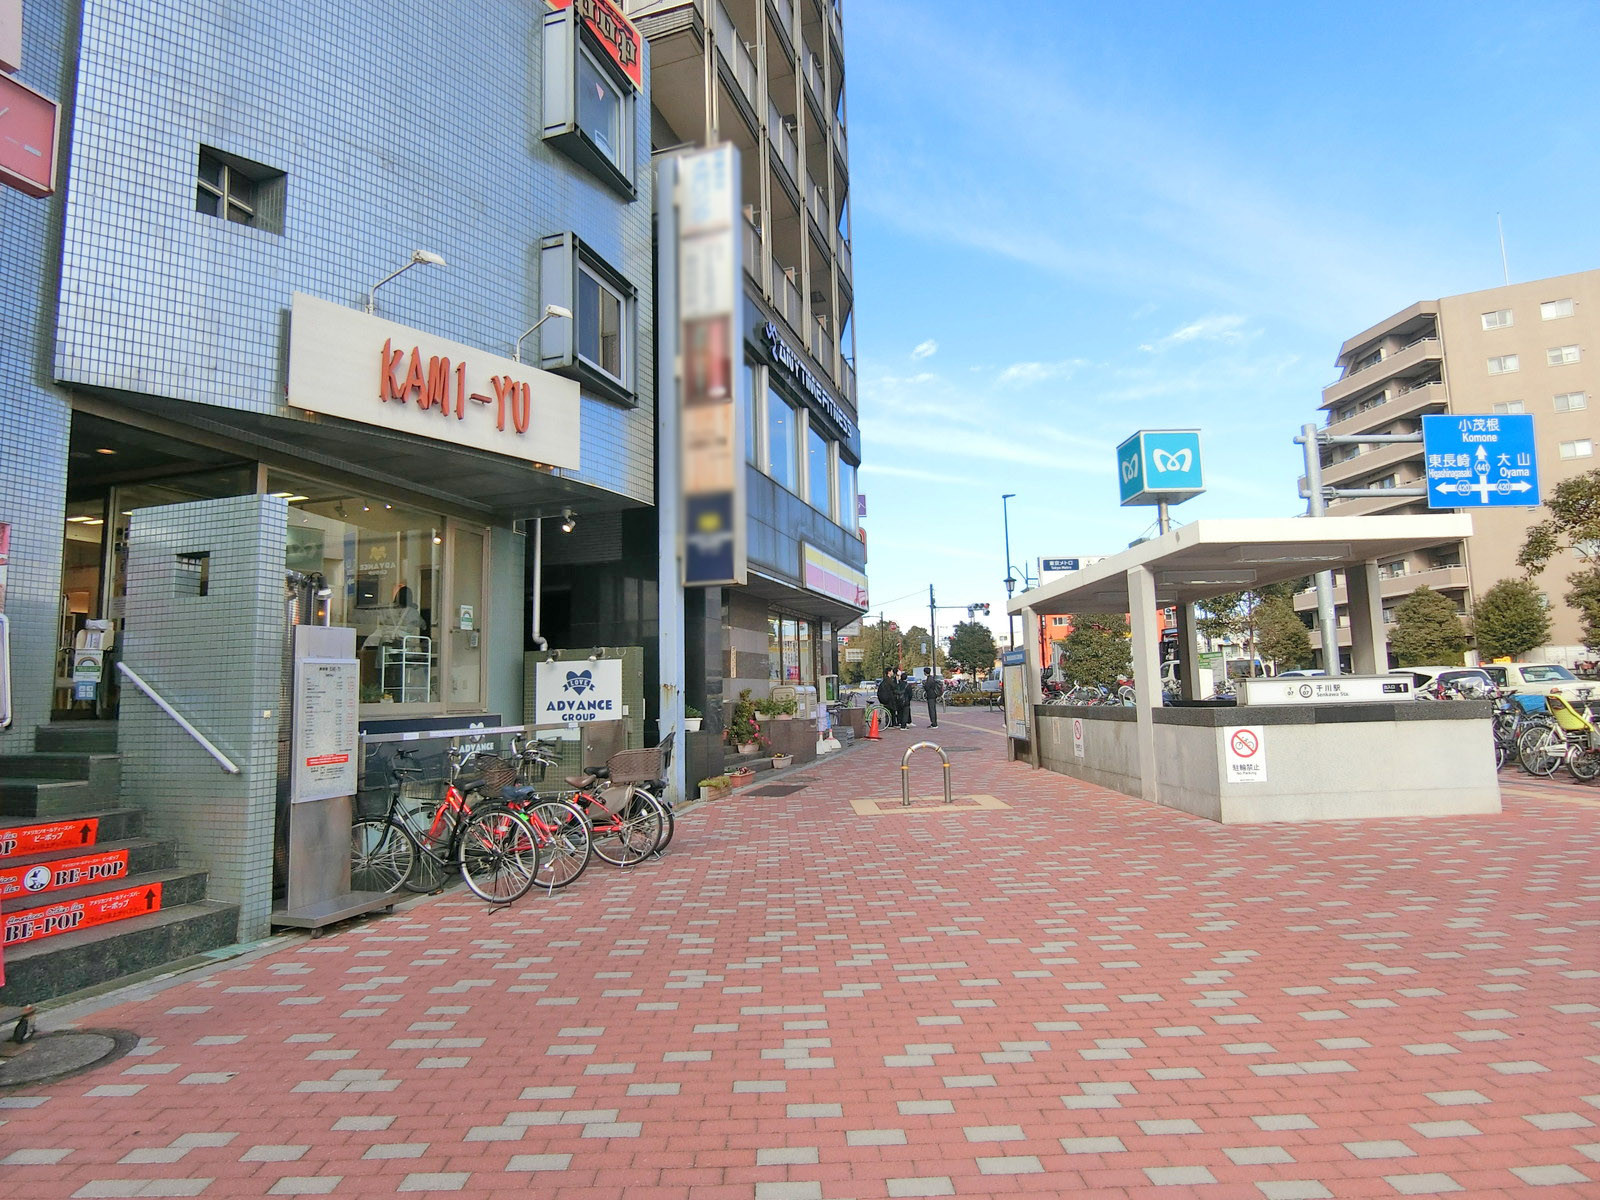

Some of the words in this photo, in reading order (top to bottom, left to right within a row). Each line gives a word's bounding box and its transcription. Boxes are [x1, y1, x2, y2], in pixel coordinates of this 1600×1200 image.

[379, 337, 531, 434] KAMI-YU
[779, 340, 822, 404] ANYTIME
[822, 389, 852, 438] FITNESS
[1458, 418, 1500, 432] 小茂根
[1462, 433, 1498, 442] Komone
[1428, 453, 1470, 468] 東長崎
[1497, 452, 1530, 467] 大山
[1428, 468, 1472, 480] Higashinagasaki
[1476, 464, 1489, 472] 441
[1500, 467, 1530, 479] Oyama
[1457, 484, 1470, 492] 420
[1498, 483, 1511, 491] 420
[1316, 684, 1341, 692] 千川駅
[1400, 684, 1405, 693] 1
[546, 700, 612, 711] ADVANCE
[562, 713, 596, 721] GROUP
[459, 742, 494, 754] ADVANCE
[54, 861, 124, 886] BE-POP
[4, 911, 84, 943] BE-POP
